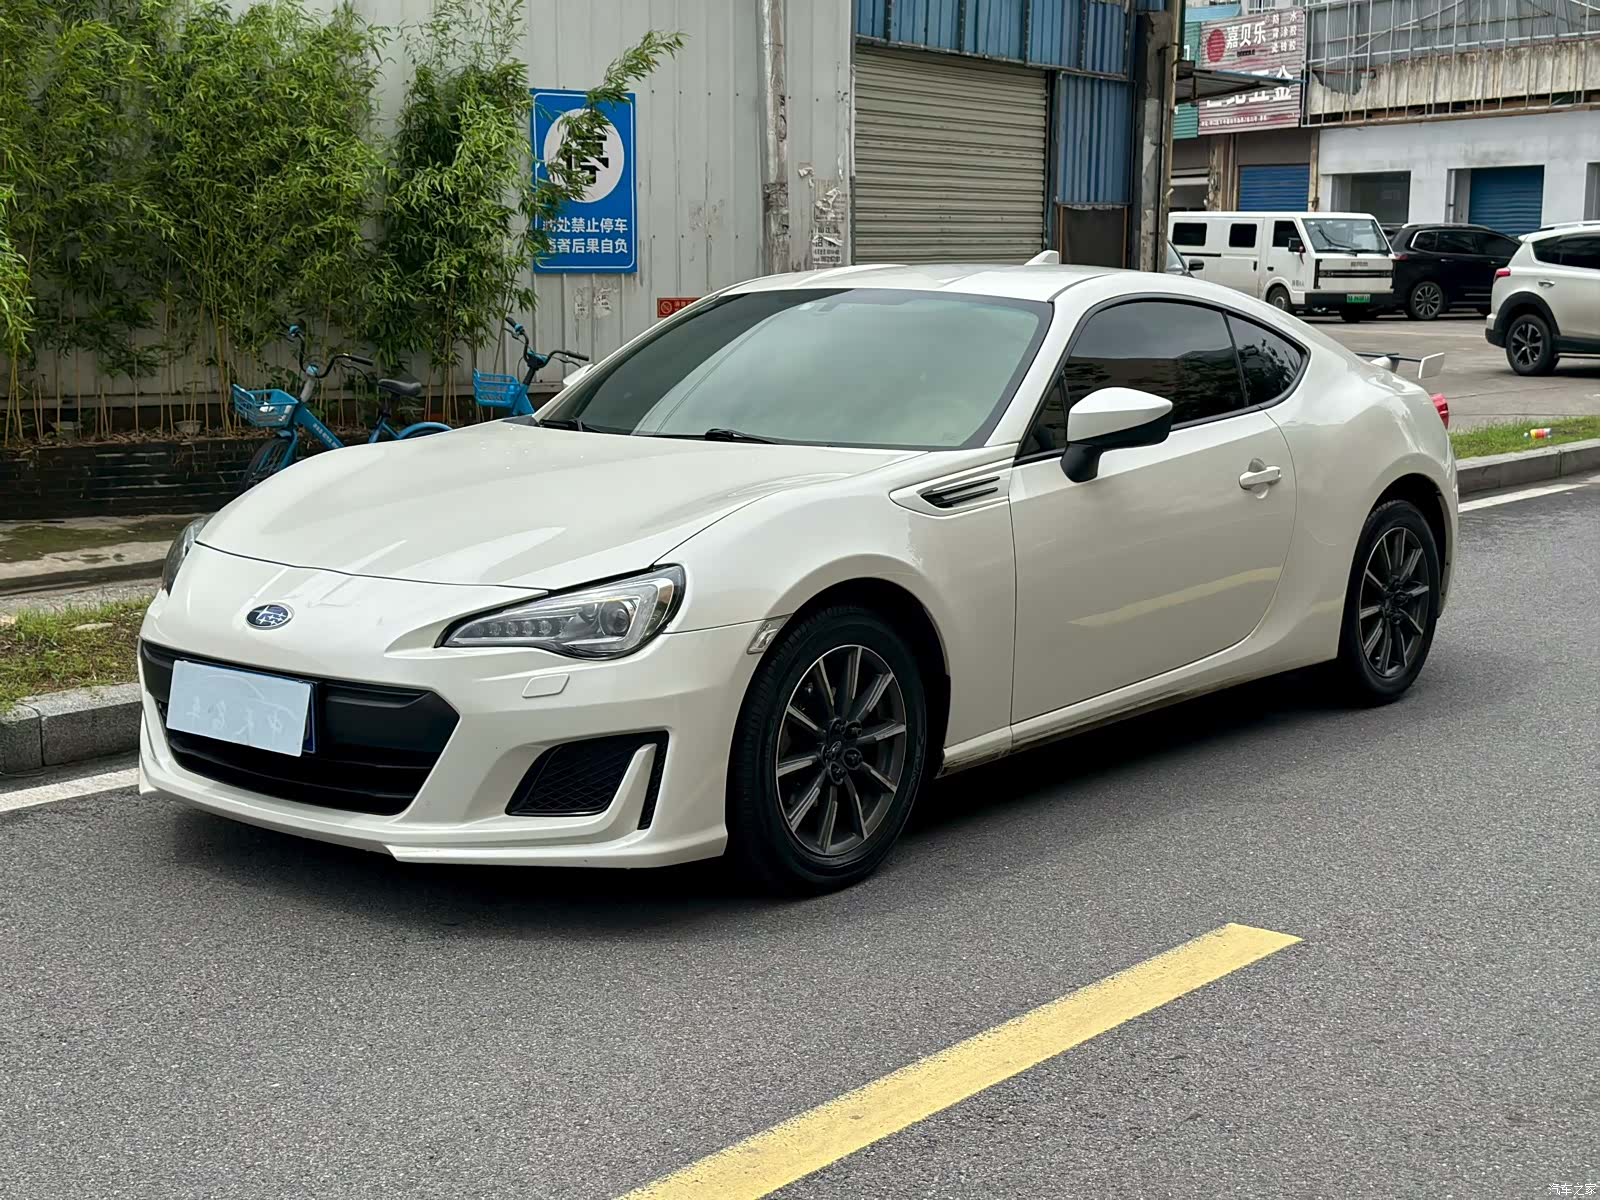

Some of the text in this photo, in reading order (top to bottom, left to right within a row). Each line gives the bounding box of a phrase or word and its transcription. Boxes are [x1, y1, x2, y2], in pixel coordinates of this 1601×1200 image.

[1226, 20, 1266, 49] 嘉贝乐
[542, 217, 628, 233] 此处禁止停车
